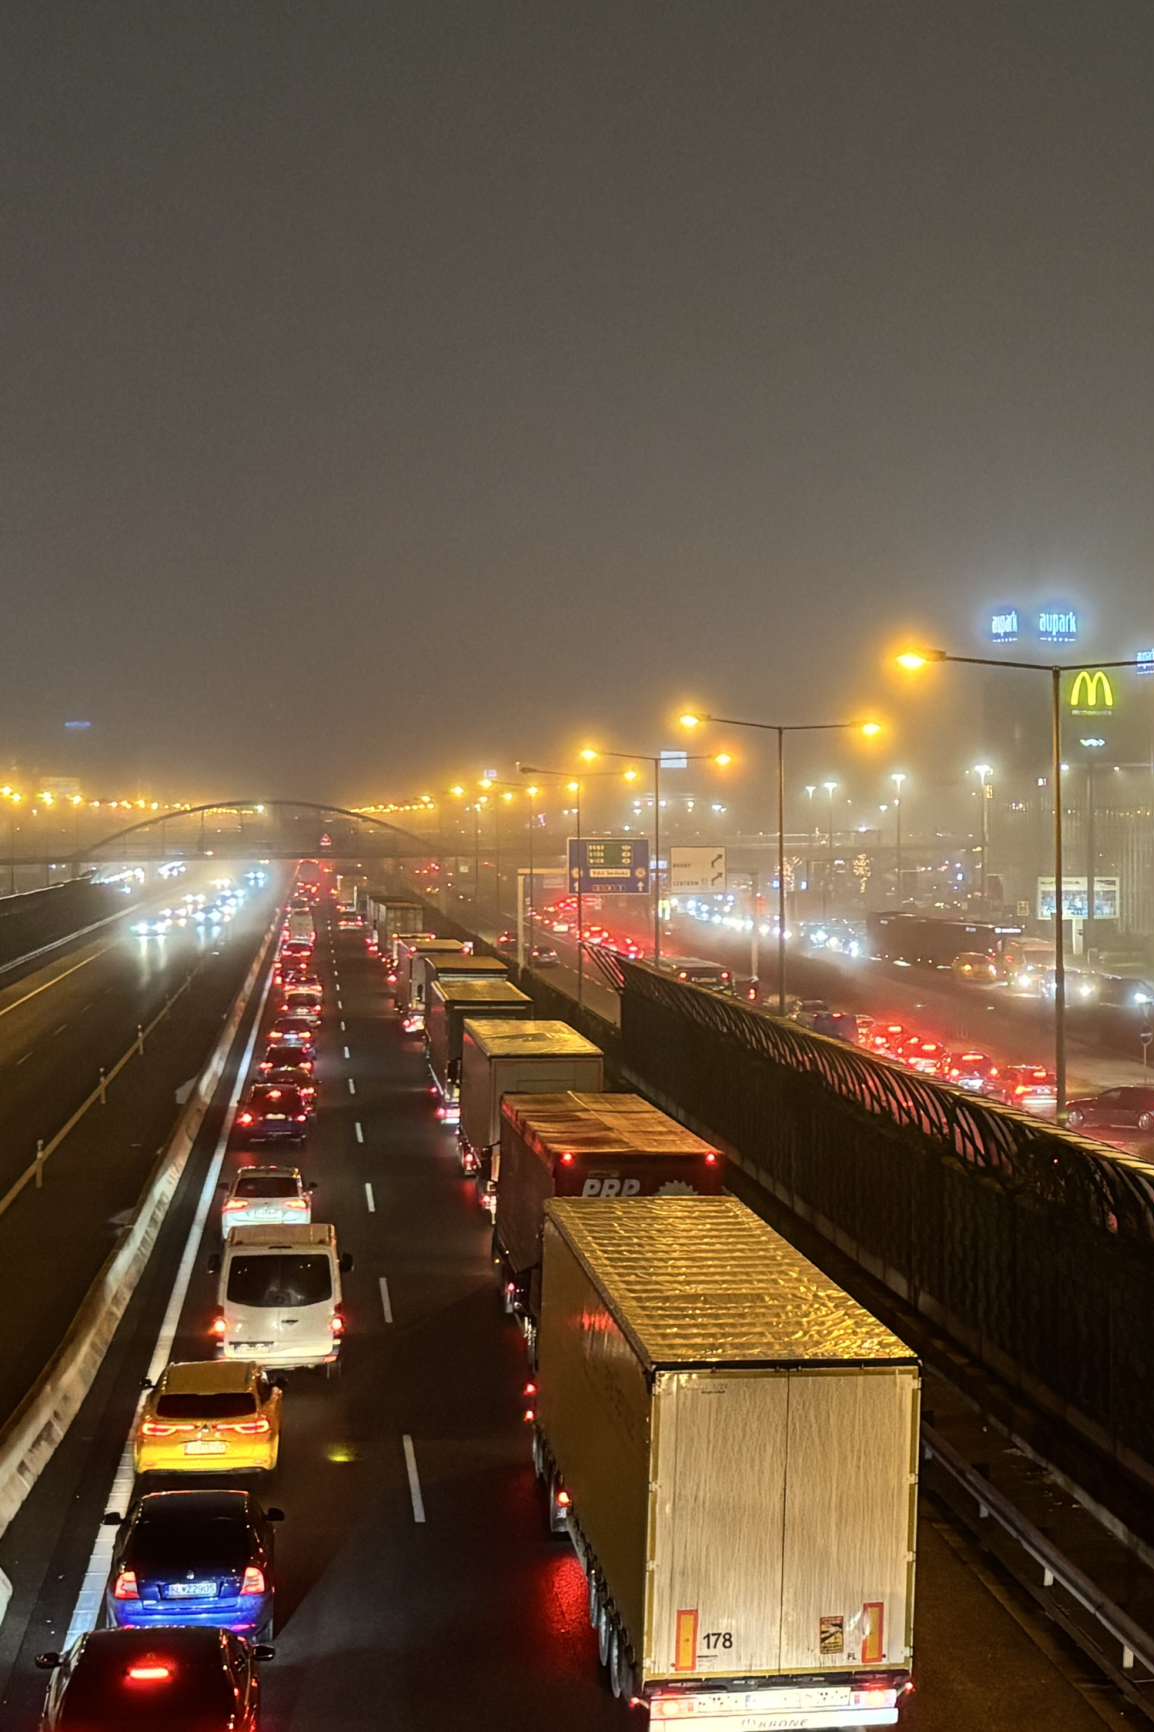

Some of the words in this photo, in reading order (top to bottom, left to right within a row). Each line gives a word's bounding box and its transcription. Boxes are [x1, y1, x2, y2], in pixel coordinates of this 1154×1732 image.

[991, 611, 1018, 636] aupark
[1039, 612, 1076, 636] aupark
[702, 1632, 733, 1649] 178
[847, 1652, 857, 1660] PL
[758, 1719, 808, 1728] KRONE
